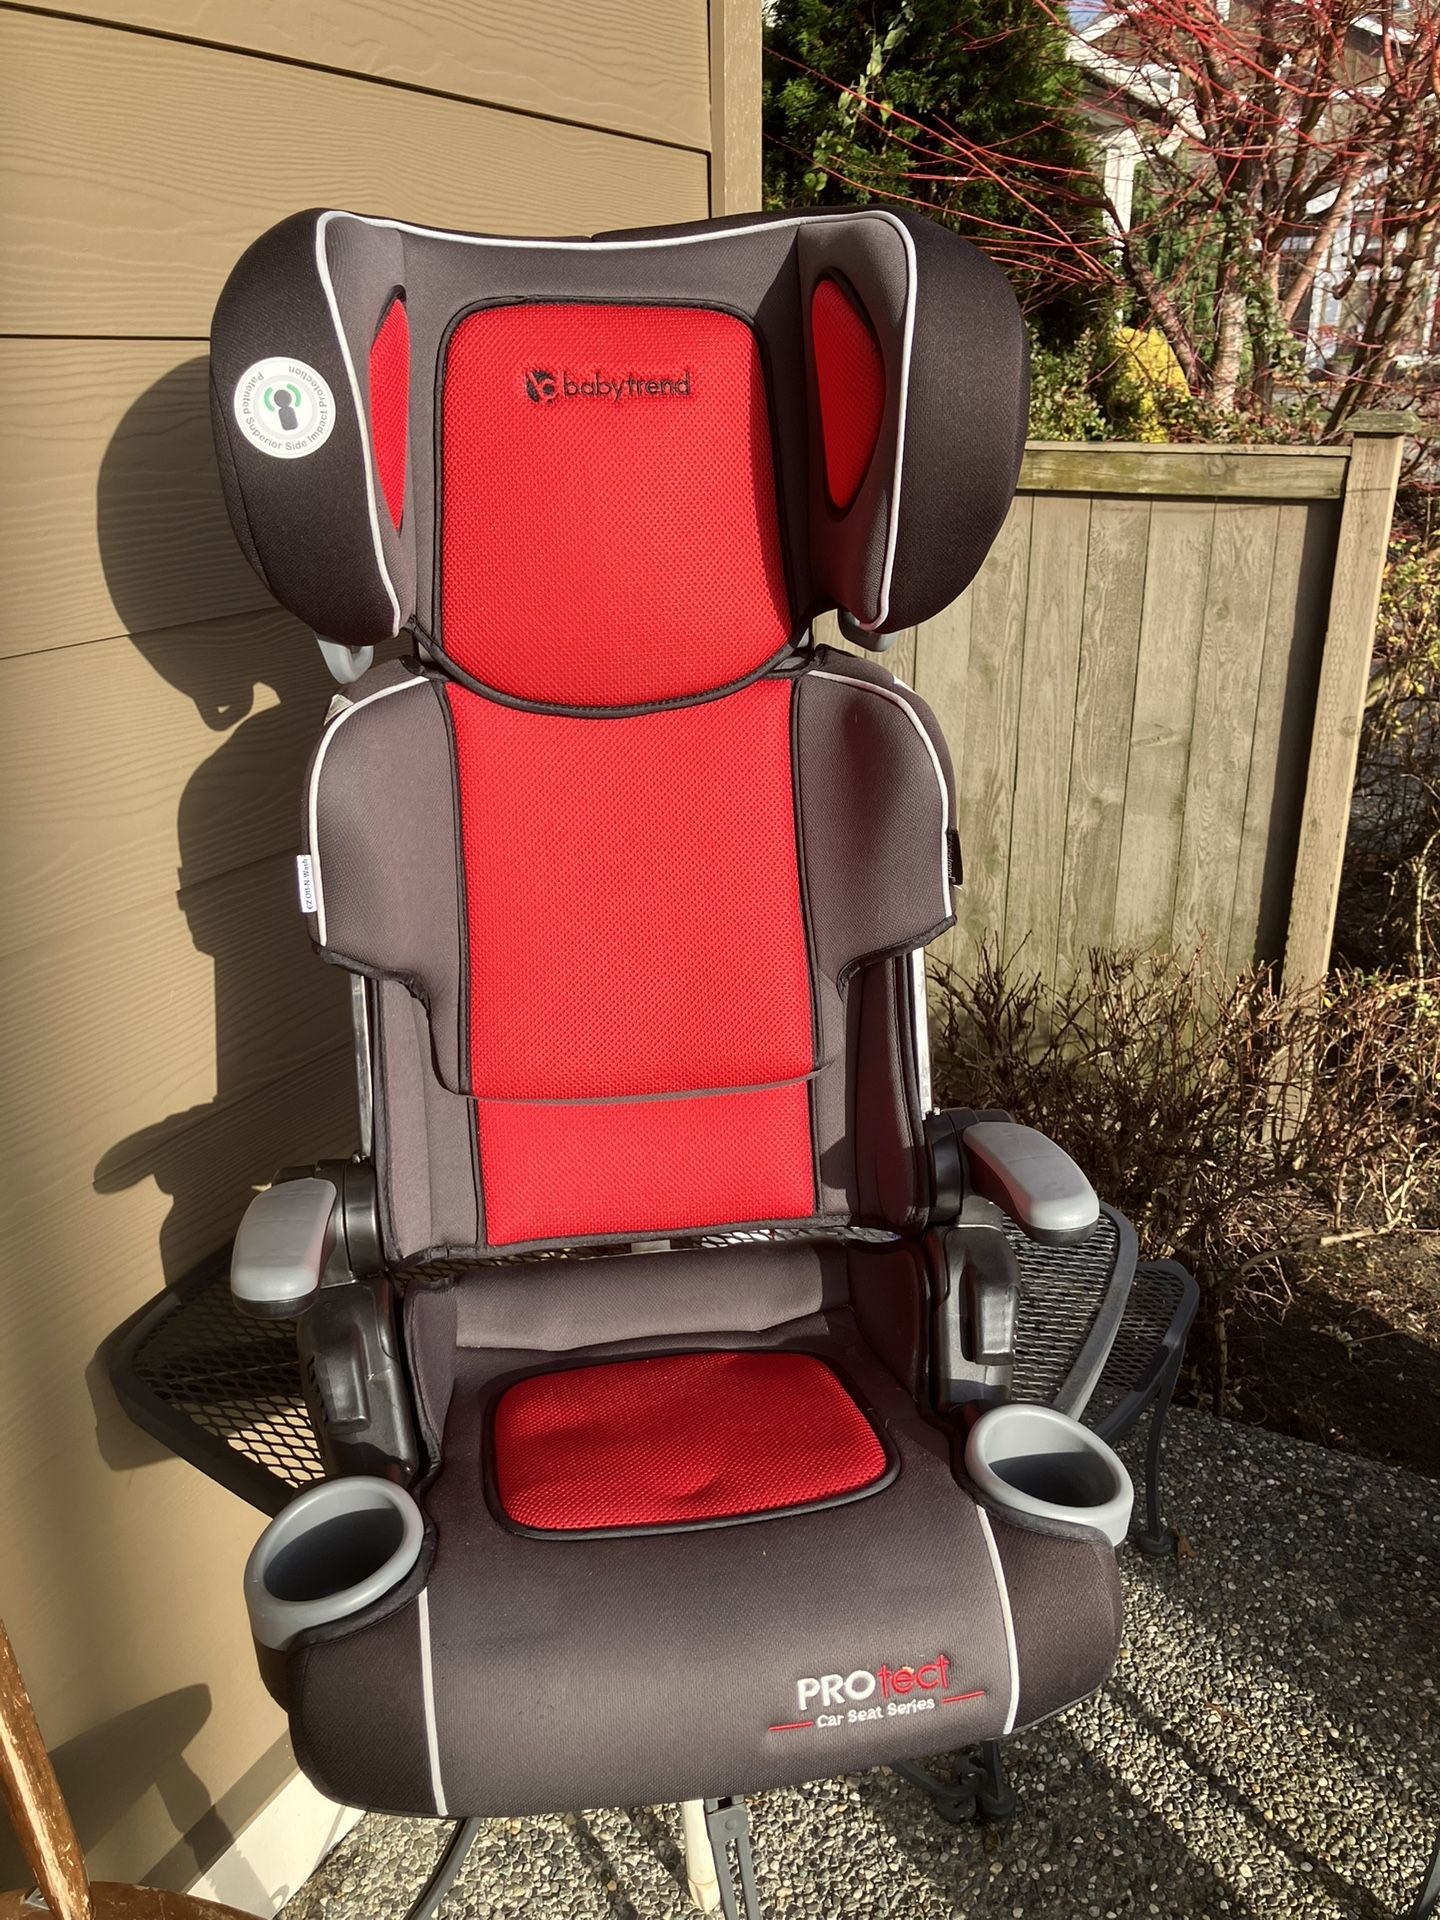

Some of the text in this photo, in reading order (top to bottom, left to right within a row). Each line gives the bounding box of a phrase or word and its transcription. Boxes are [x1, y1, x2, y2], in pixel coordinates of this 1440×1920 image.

[242, 365, 328, 451] Patented Superior Side Impact Protection
[562, 371, 692, 402] babytrend
[797, 1653, 949, 1711] PROtect
[816, 1698, 935, 1728] Car Seat Series
